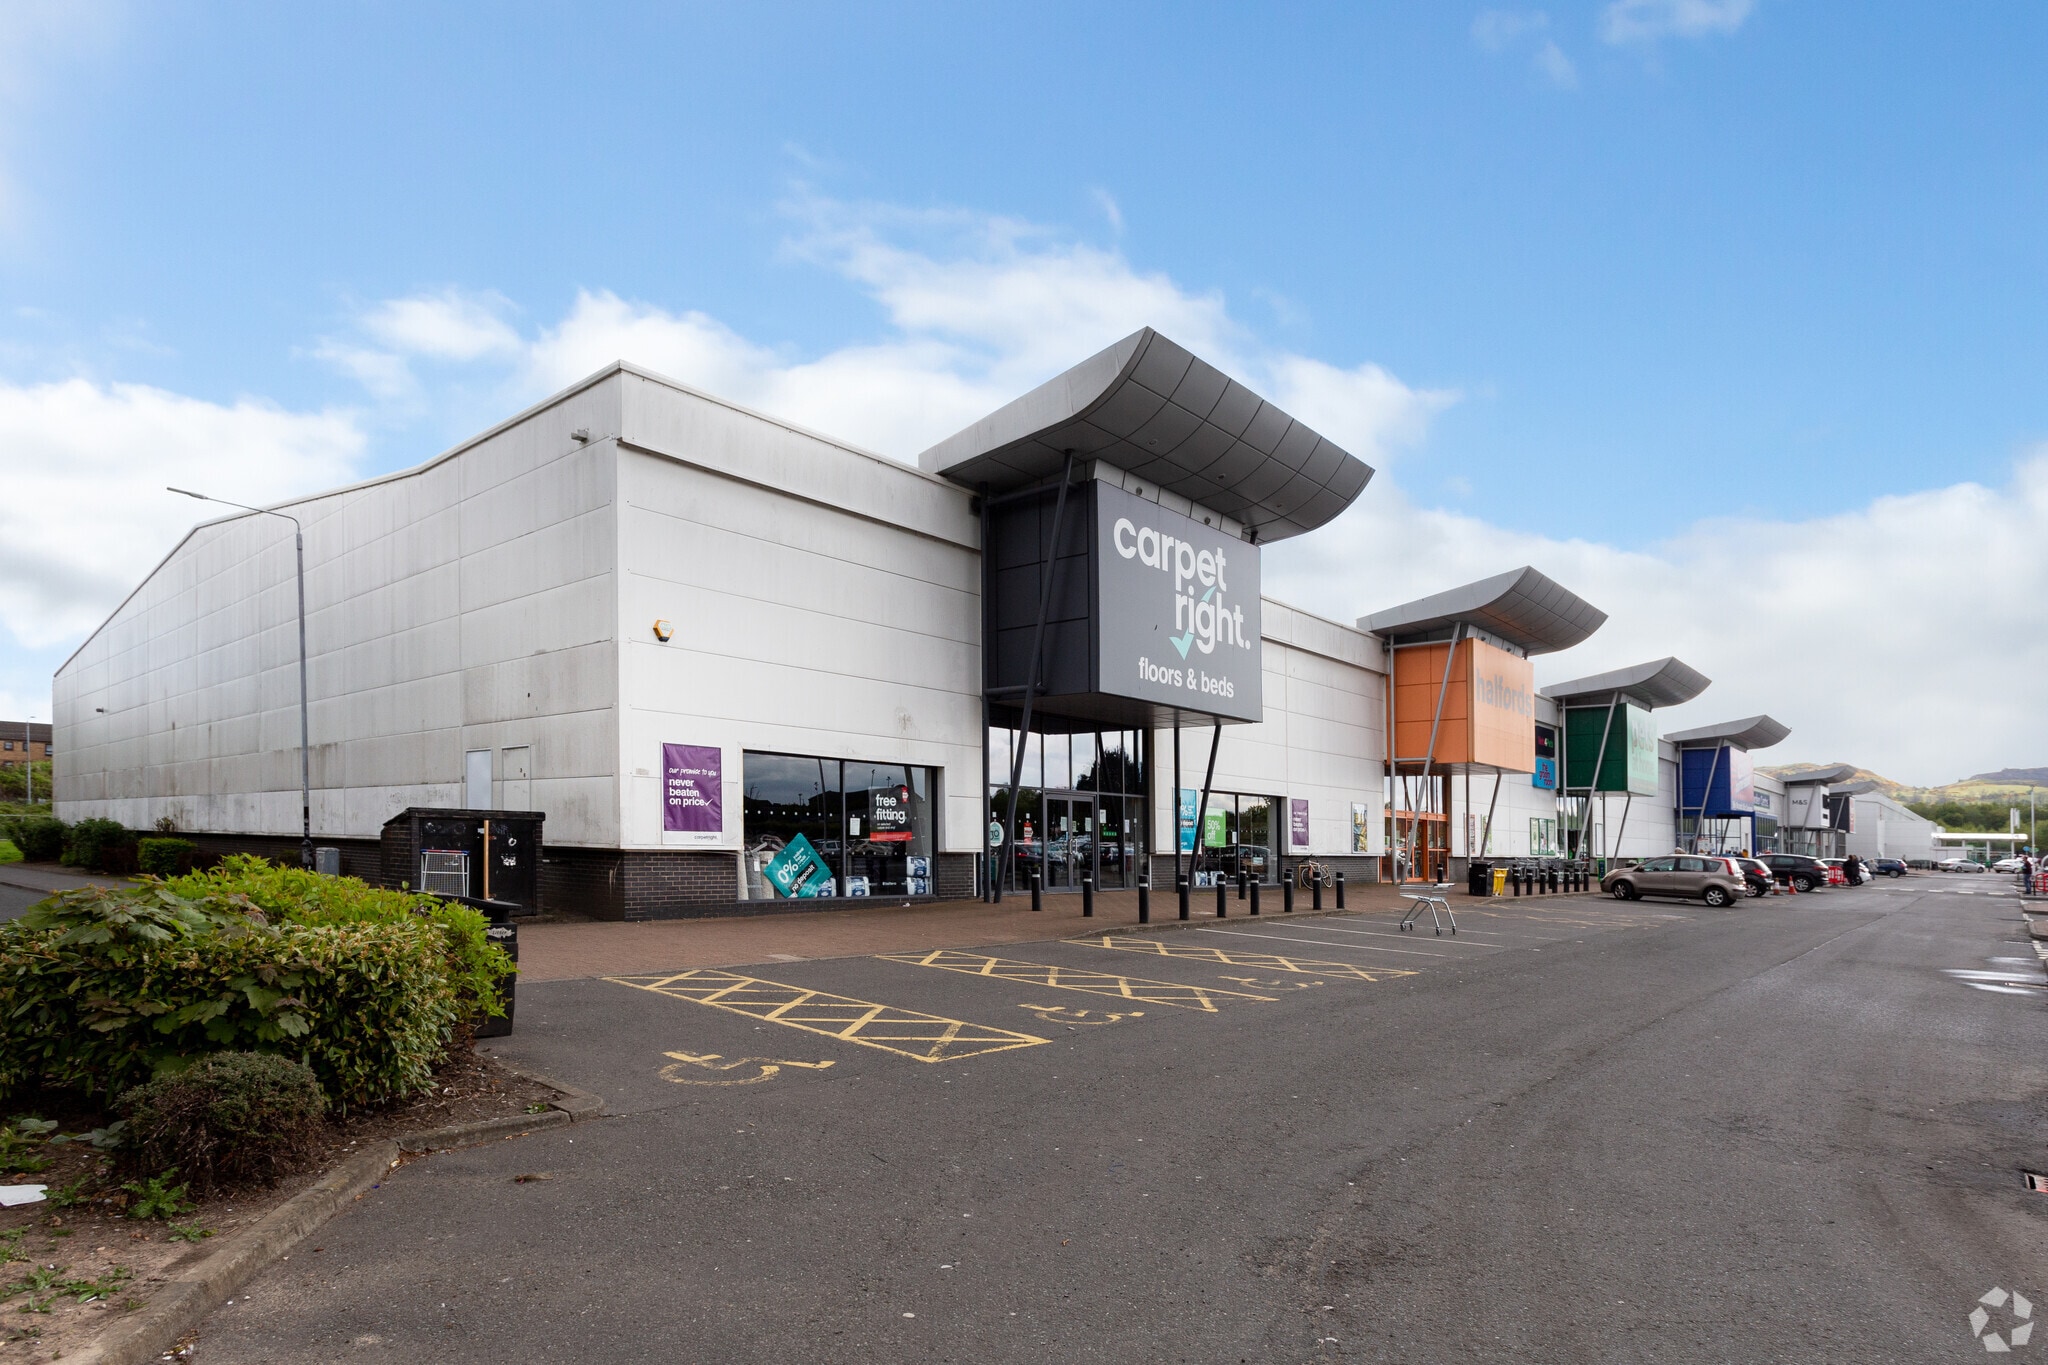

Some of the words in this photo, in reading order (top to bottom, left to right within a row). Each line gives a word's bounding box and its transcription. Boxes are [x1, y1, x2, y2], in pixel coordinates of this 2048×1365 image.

[1113, 517, 1227, 592] carpet
[1175, 585, 1251, 654] right.
[1138, 656, 1183, 687] floors
[1186, 668, 1197, 691] &
[1201, 671, 1235, 698] beds
[1476, 668, 1533, 719] halfords
[668, 767, 680, 775] our
[679, 767, 701, 777] promise
[701, 768, 708, 776] to
[707, 770, 717, 778] you
[668, 778, 695, 787] never
[669, 787, 700, 798] beaten
[875, 793, 897, 807] free
[669, 797, 682, 806] on
[683, 797, 705, 808] price
[875, 807, 906, 824] fitting
[1207, 819, 1221, 831] 50%
[1207, 830, 1216, 841] off
[777, 859, 799, 884] 0%
[791, 883, 799, 892] no
[797, 864, 816, 885] deposit
